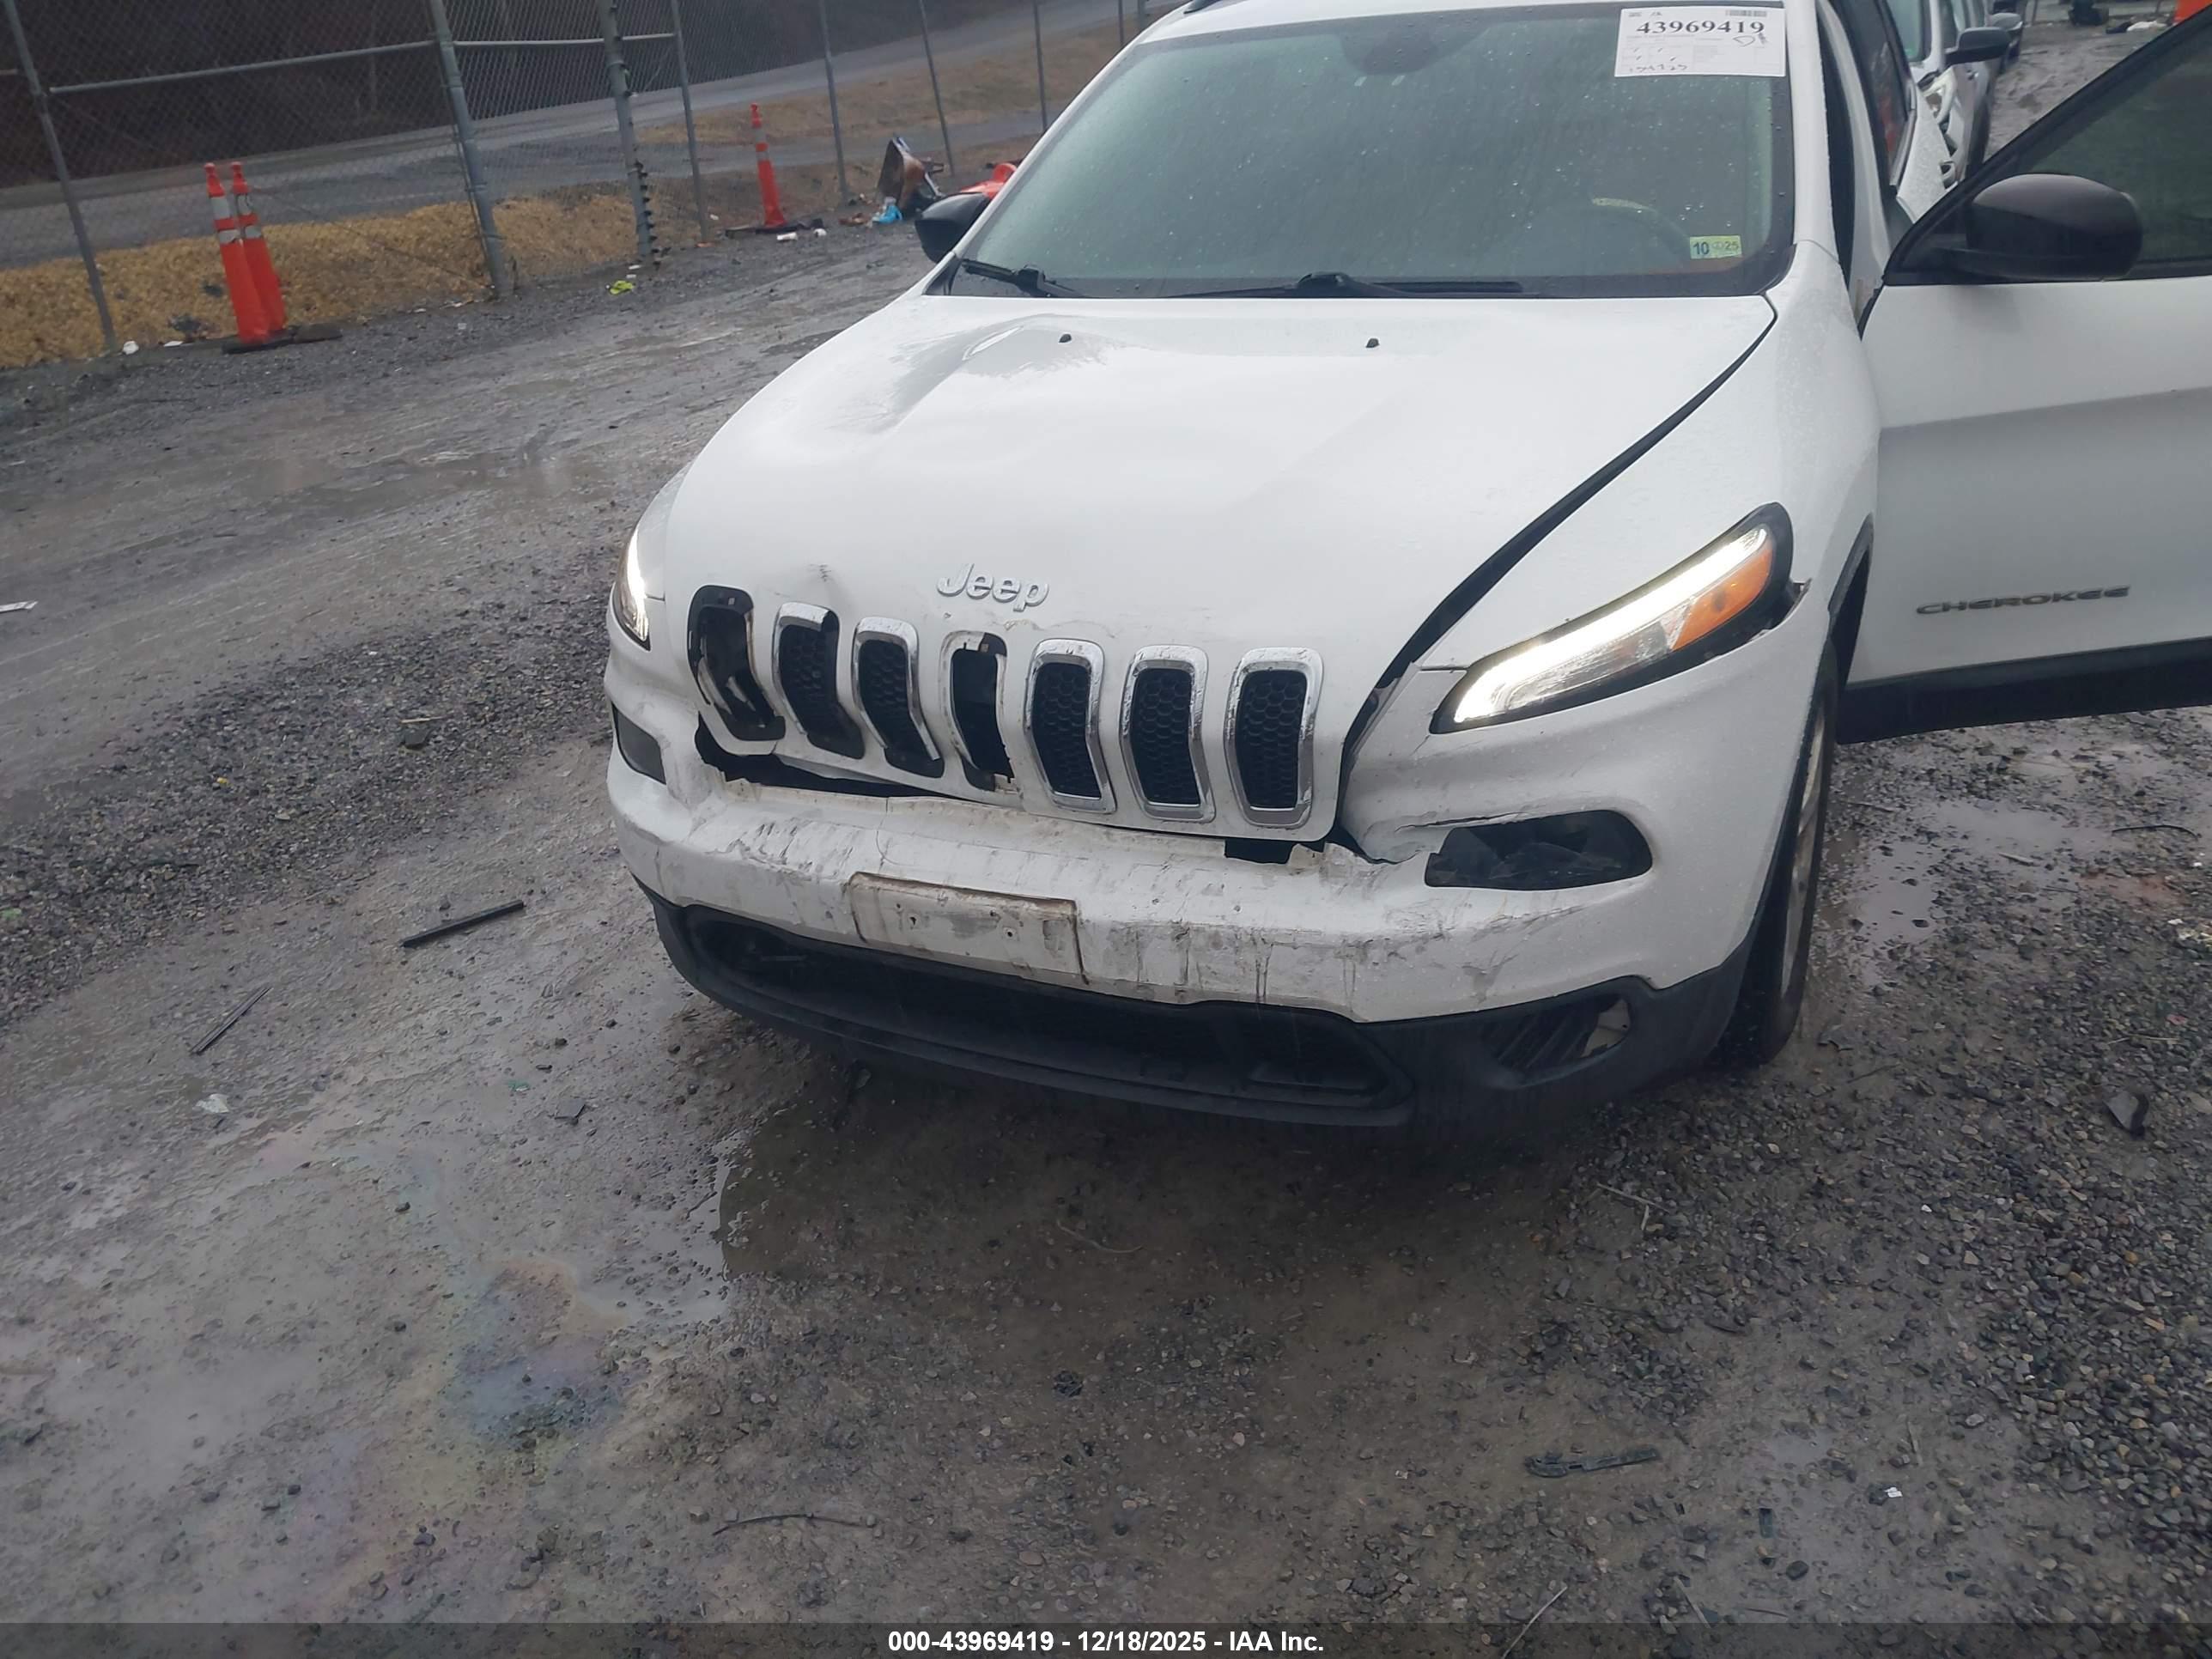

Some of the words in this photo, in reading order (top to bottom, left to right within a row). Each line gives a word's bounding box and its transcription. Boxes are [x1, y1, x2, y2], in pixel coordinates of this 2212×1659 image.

[1637, 20, 1765, 34] 43969419
[1692, 241, 1710, 255] 10
[1724, 240, 1739, 251] 25
[937, 563, 1049, 612] Jeep
[1916, 586, 2130, 614] CHEROKEE
